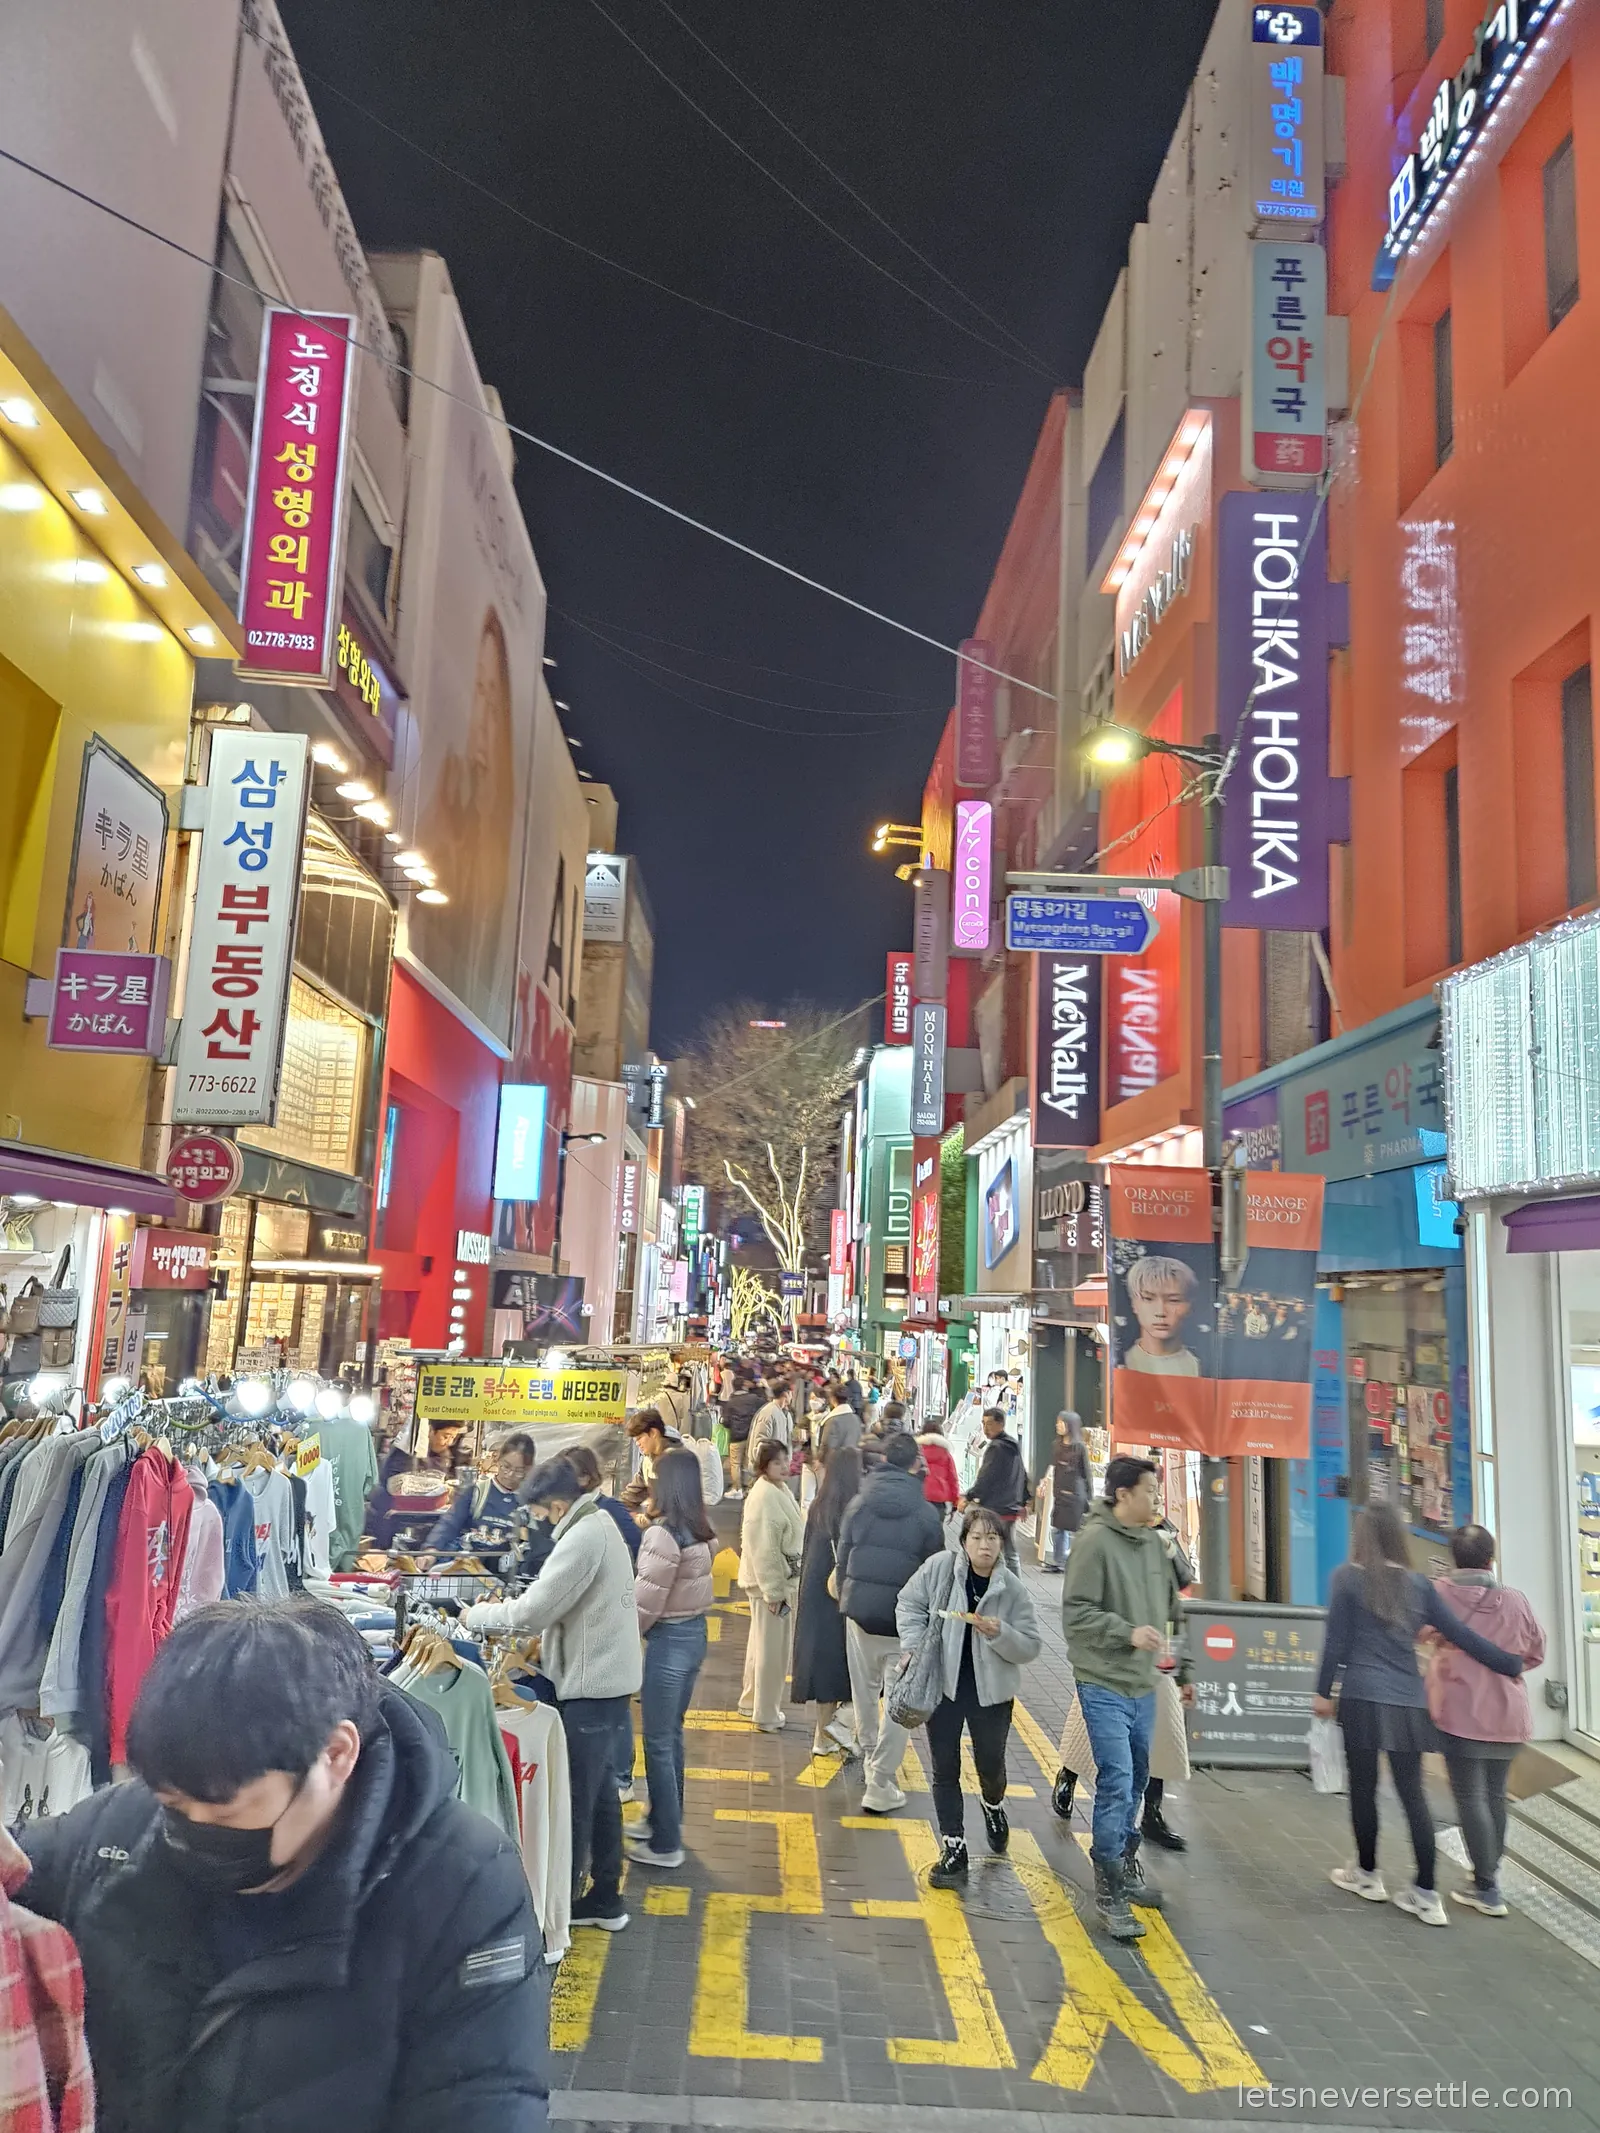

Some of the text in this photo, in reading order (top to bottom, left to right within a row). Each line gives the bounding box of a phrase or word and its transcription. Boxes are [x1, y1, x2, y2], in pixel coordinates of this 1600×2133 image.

[1270, 178, 1304, 198] 의원
[1266, 258, 1313, 423] 푸른약국
[264, 332, 331, 621] 노정식 성형외과
[248, 629, 315, 651] 02.778-7933
[337, 624, 381, 718] 성형외과
[1250, 512, 1299, 899] HOLIKA HOLIKA
[94, 808, 151, 882] キラ星
[99, 862, 138, 908] かばん
[1013, 901, 1088, 920] 명동8가길
[1013, 921, 1089, 937] Myeongdong
[60, 972, 150, 1006] キラ星
[67, 1012, 136, 1038] かばん
[1041, 963, 1089, 1120] McNally
[923, 1011, 936, 1104] MOON HAIR
[188, 1074, 257, 1094] 773-6622
[1341, 1062, 1442, 1140] 푸른약국
[621, 1165, 637, 1228] BANILA CO
[1040, 1180, 1086, 1220] LLOYD
[1124, 1187, 1195, 1203] ORANGE
[1131, 1202, 1190, 1217] BLOOD
[457, 1230, 491, 1265] MISSHA
[450, 1376, 478, 1398] 군밤,
[528, 1378, 557, 1401] 은행,
[424, 1405, 441, 1414] Roast
[441, 1406, 470, 1414] Chestnuts
[483, 1407, 501, 1416] Roast
[501, 1407, 517, 1416] Corn
[522, 1408, 535, 1416] Roast
[567, 1409, 583, 1418] Squid
[584, 1410, 596, 1418] with
